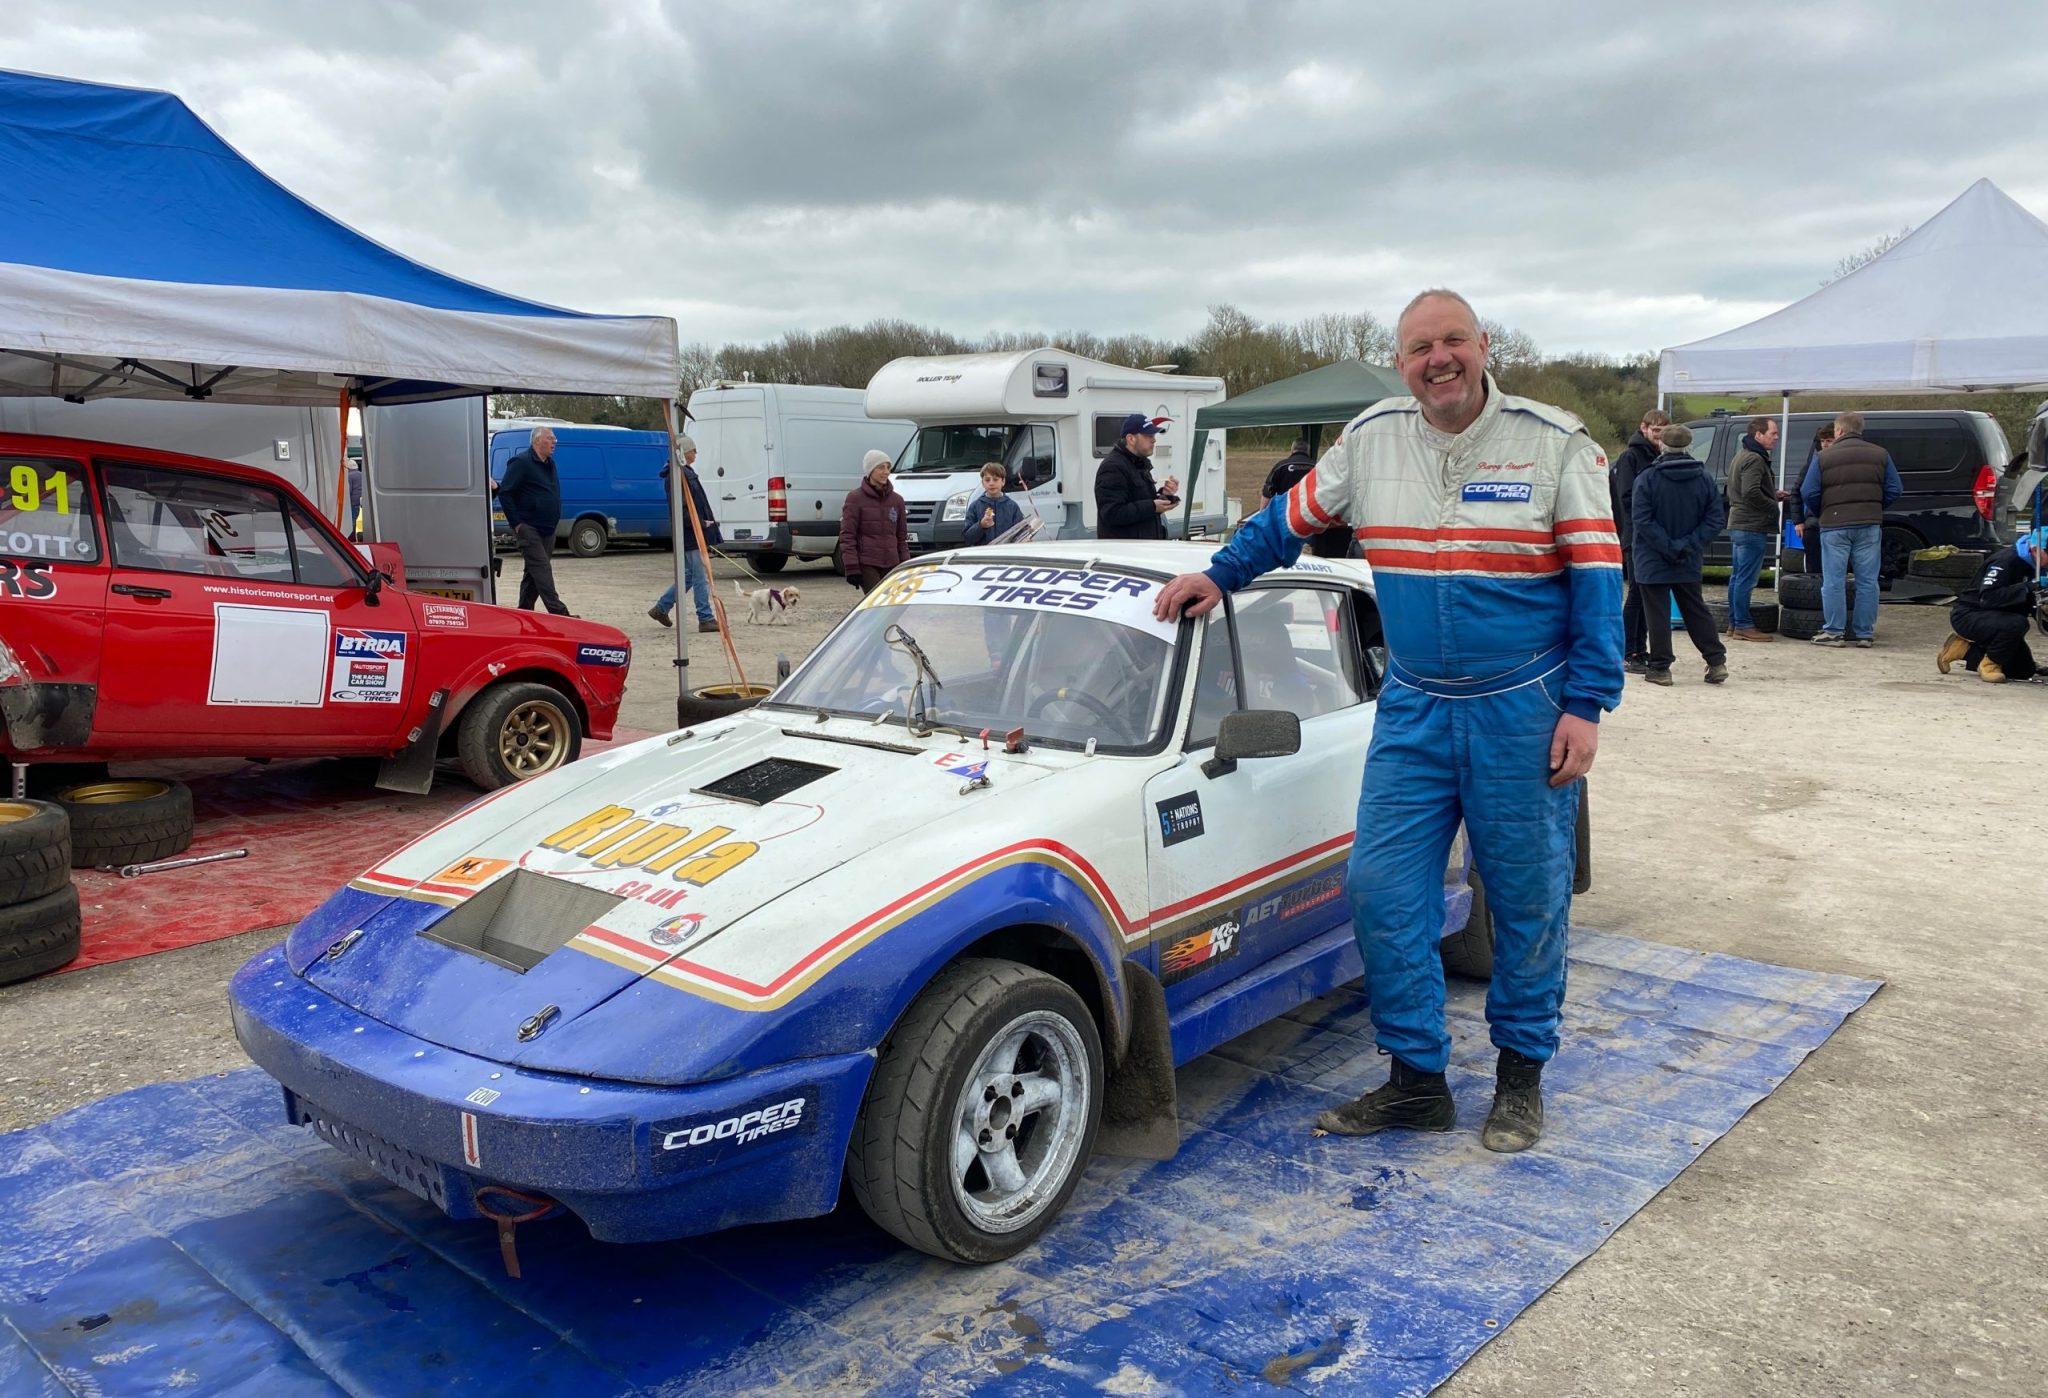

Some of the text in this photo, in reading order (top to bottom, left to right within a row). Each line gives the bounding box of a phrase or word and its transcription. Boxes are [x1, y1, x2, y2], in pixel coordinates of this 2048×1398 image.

[10, 465, 69, 515] 91
[1464, 484, 1531, 494] COOPER
[1495, 491, 1528, 499] TIRES
[971, 565, 1152, 598] COOPER
[203, 585, 335, 603] www.historicmotorsport.net
[978, 585, 1106, 611] TIRES
[340, 636, 401, 653] BTRDA
[581, 648, 627, 659] COOPER
[1174, 803, 1199, 820] NATIONS
[1161, 811, 1171, 836] 5
[1177, 816, 1200, 831] TROPHY
[607, 880, 688, 911] .co.uk
[468, 1088, 498, 1105] TOW
[662, 1097, 806, 1150] COOPER
[735, 1114, 802, 1146] TIRES
